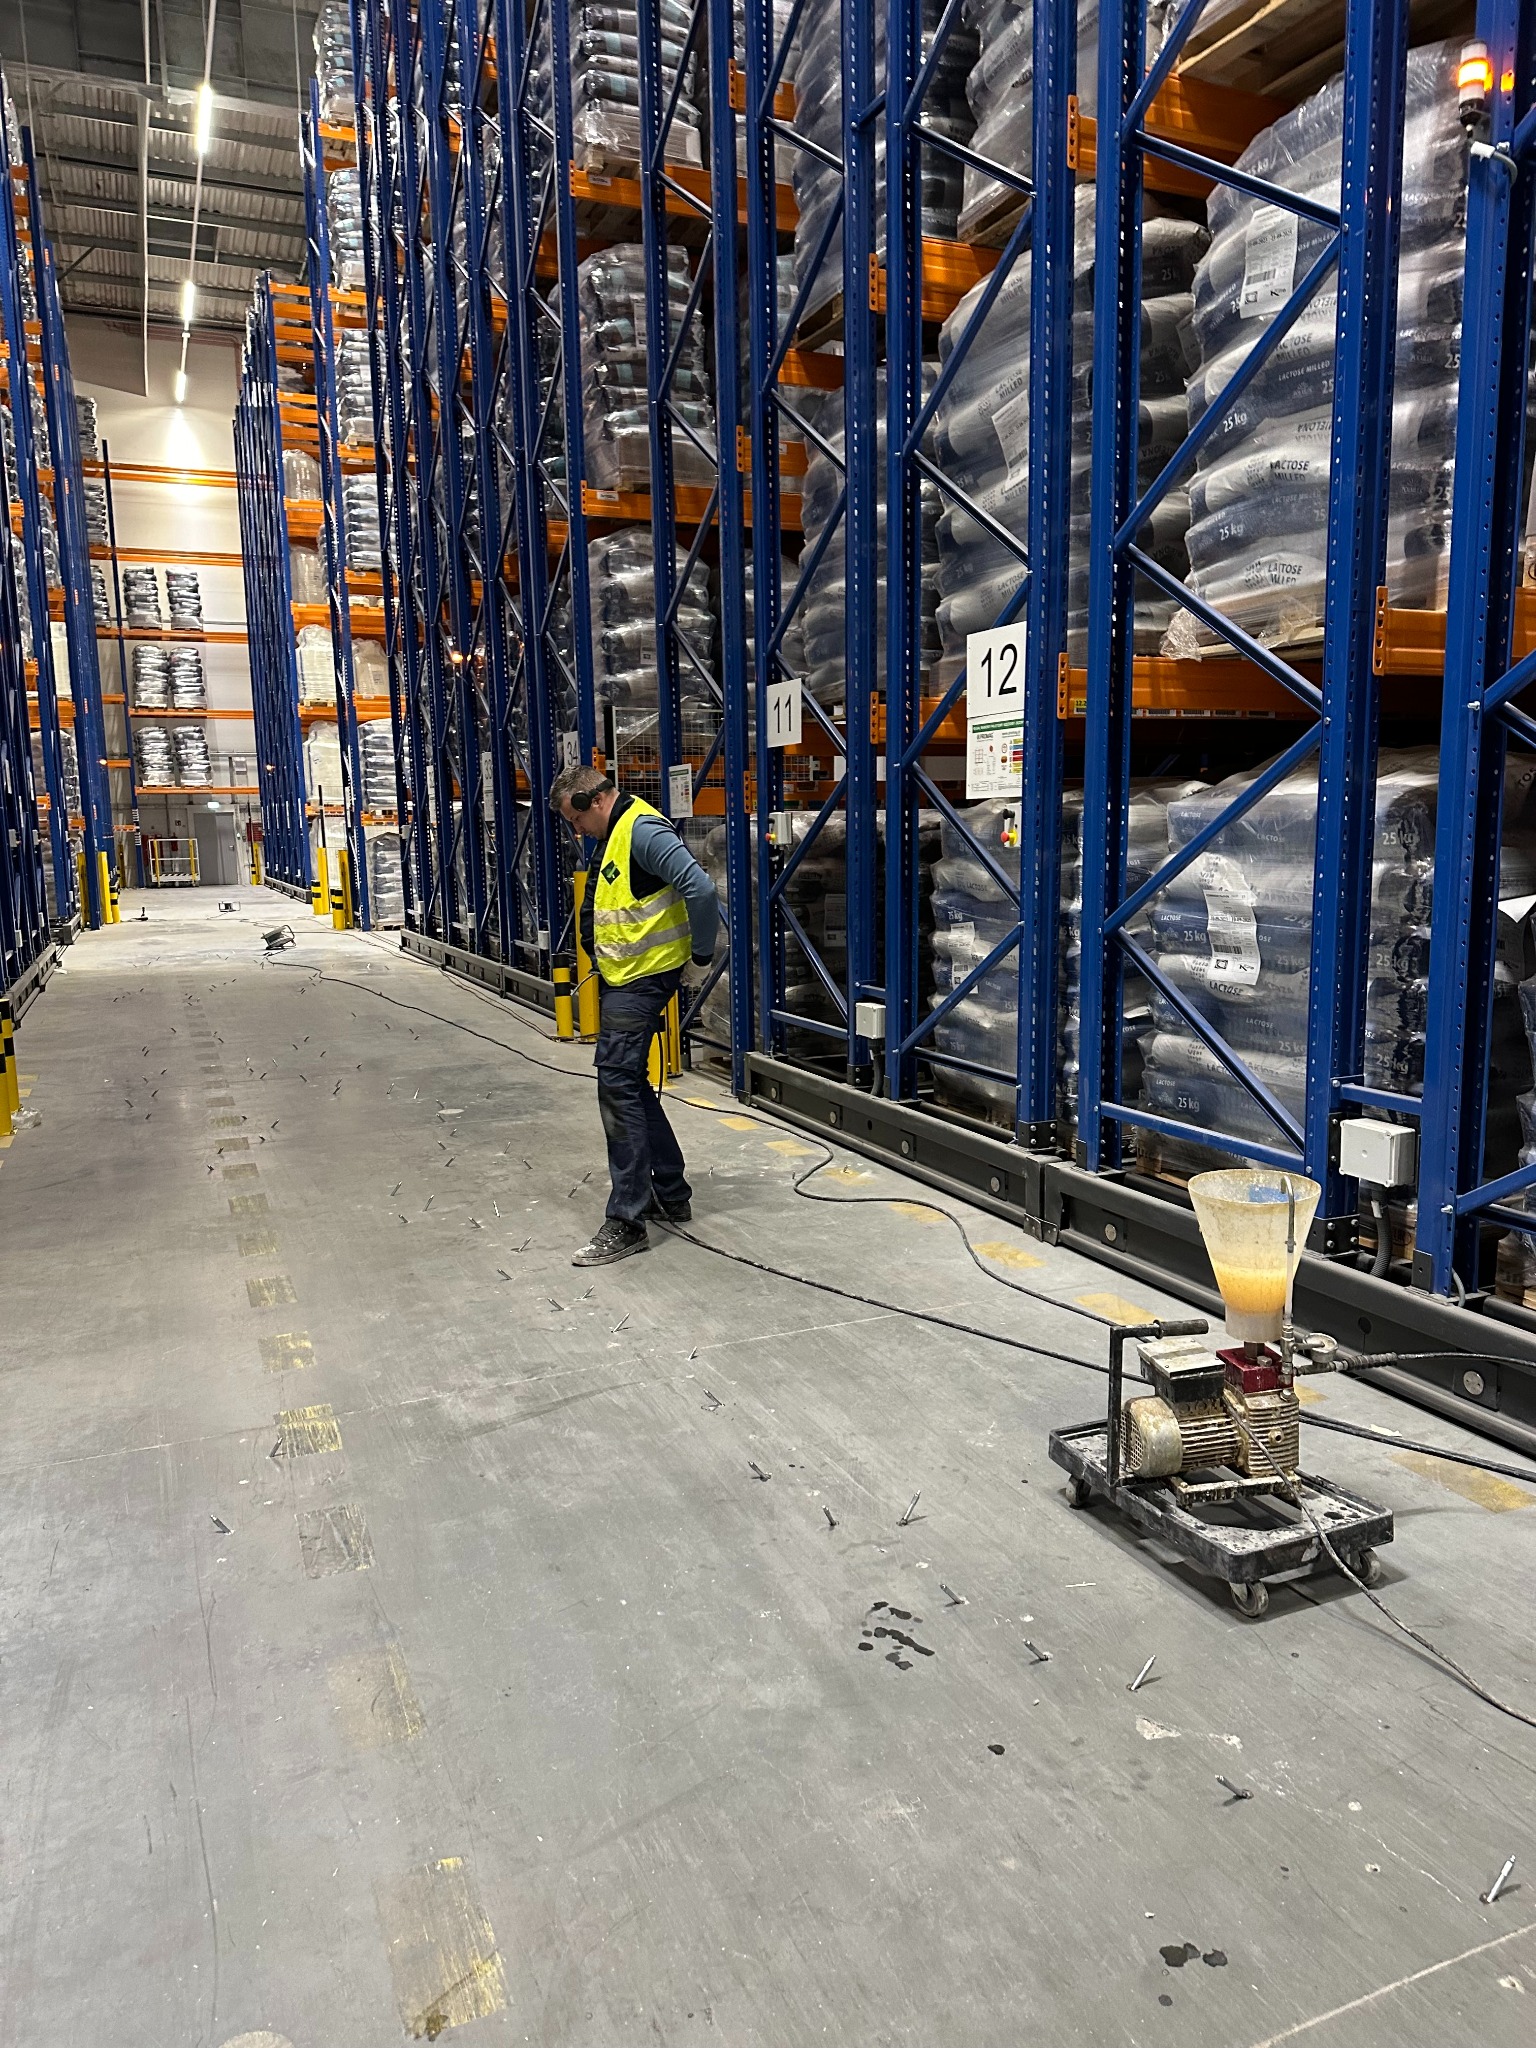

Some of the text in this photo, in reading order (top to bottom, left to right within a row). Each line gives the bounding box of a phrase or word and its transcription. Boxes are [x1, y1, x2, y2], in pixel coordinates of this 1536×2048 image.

[1275, 332, 1312, 351] ACTOSE
[1278, 367, 1305, 382] LACTOSE
[1223, 411, 1247, 433] 25 kg
[1219, 522, 1244, 541] 25 kg
[981, 643, 1018, 698] 12
[774, 694, 792, 734] 11
[1382, 832, 1396, 845] 25
[1184, 930, 1206, 943] 25 kg
[1376, 953, 1390, 966] 25
[1209, 981, 1243, 996] LACTOSE
[1246, 1017, 1274, 1029] LACTOSE
[1279, 1040, 1292, 1052] 25
[1376, 1054, 1389, 1067] 25
[1156, 1079, 1176, 1087] LACTOSE
[1178, 1097, 1200, 1112] 25 kg
